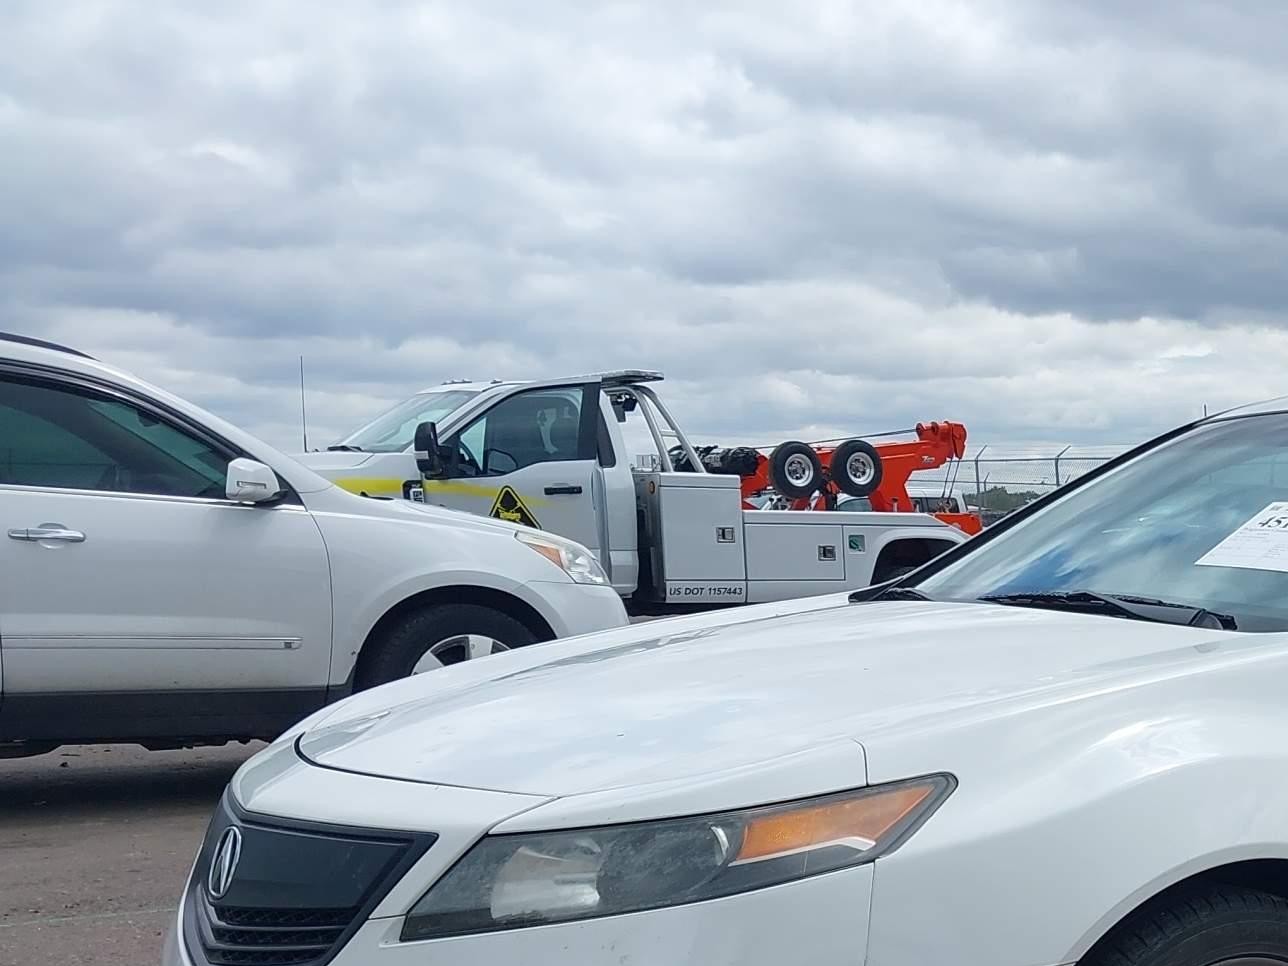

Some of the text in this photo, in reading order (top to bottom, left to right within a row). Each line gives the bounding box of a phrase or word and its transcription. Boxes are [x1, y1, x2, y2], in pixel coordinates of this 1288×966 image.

[669, 587, 743, 596] US DOT 1157443
